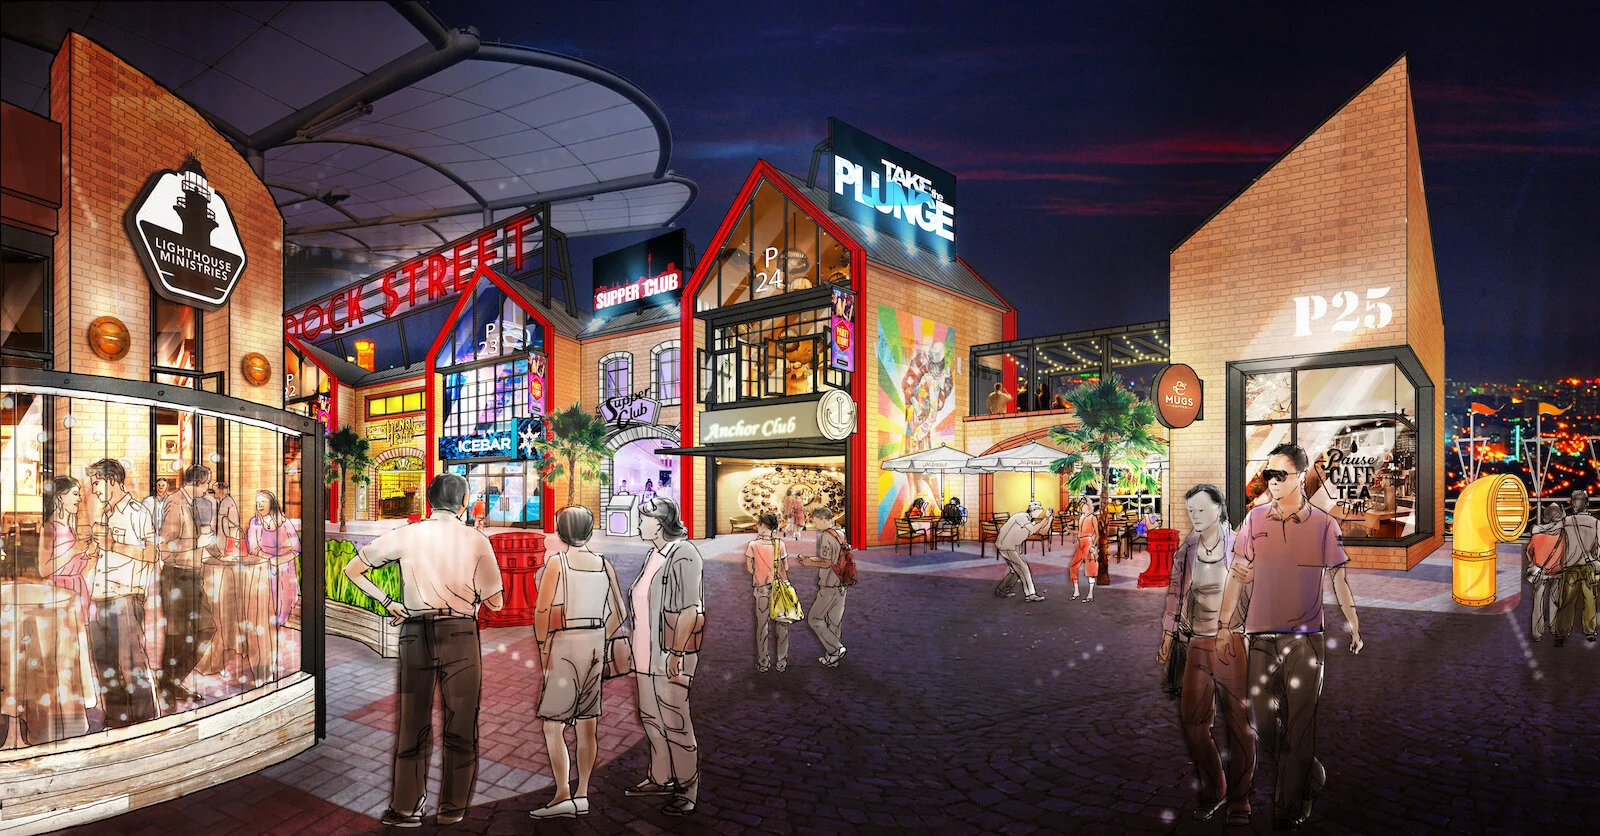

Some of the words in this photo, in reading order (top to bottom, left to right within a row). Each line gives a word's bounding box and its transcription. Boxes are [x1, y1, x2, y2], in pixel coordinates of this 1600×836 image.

[881, 158, 932, 195] TAKE
[930, 188, 944, 202] the
[835, 155, 955, 242] PLUNGE
[155, 237, 232, 273] LIGHTHOUSE
[160, 250, 228, 281] MINISTRIES
[382, 216, 534, 315] STREET
[765, 247, 778, 268] P
[596, 283, 640, 310] SUPPER
[643, 272, 679, 298] CLUB
[755, 269, 783, 293] 24
[1293, 286, 1393, 337] P25
[485, 323, 496, 339] P
[478, 340, 498, 357] 23
[286, 373, 294, 386] P
[605, 387, 651, 423] Supper
[1165, 394, 1194, 407] MUGS
[617, 402, 648, 429] Club
[704, 419, 760, 441] Anchor
[762, 416, 796, 437] Club
[458, 437, 511, 453] ICEBAR
[1321, 448, 1378, 470] Pause
[1329, 466, 1375, 485] CAFE
[1336, 485, 1371, 499] TEA
